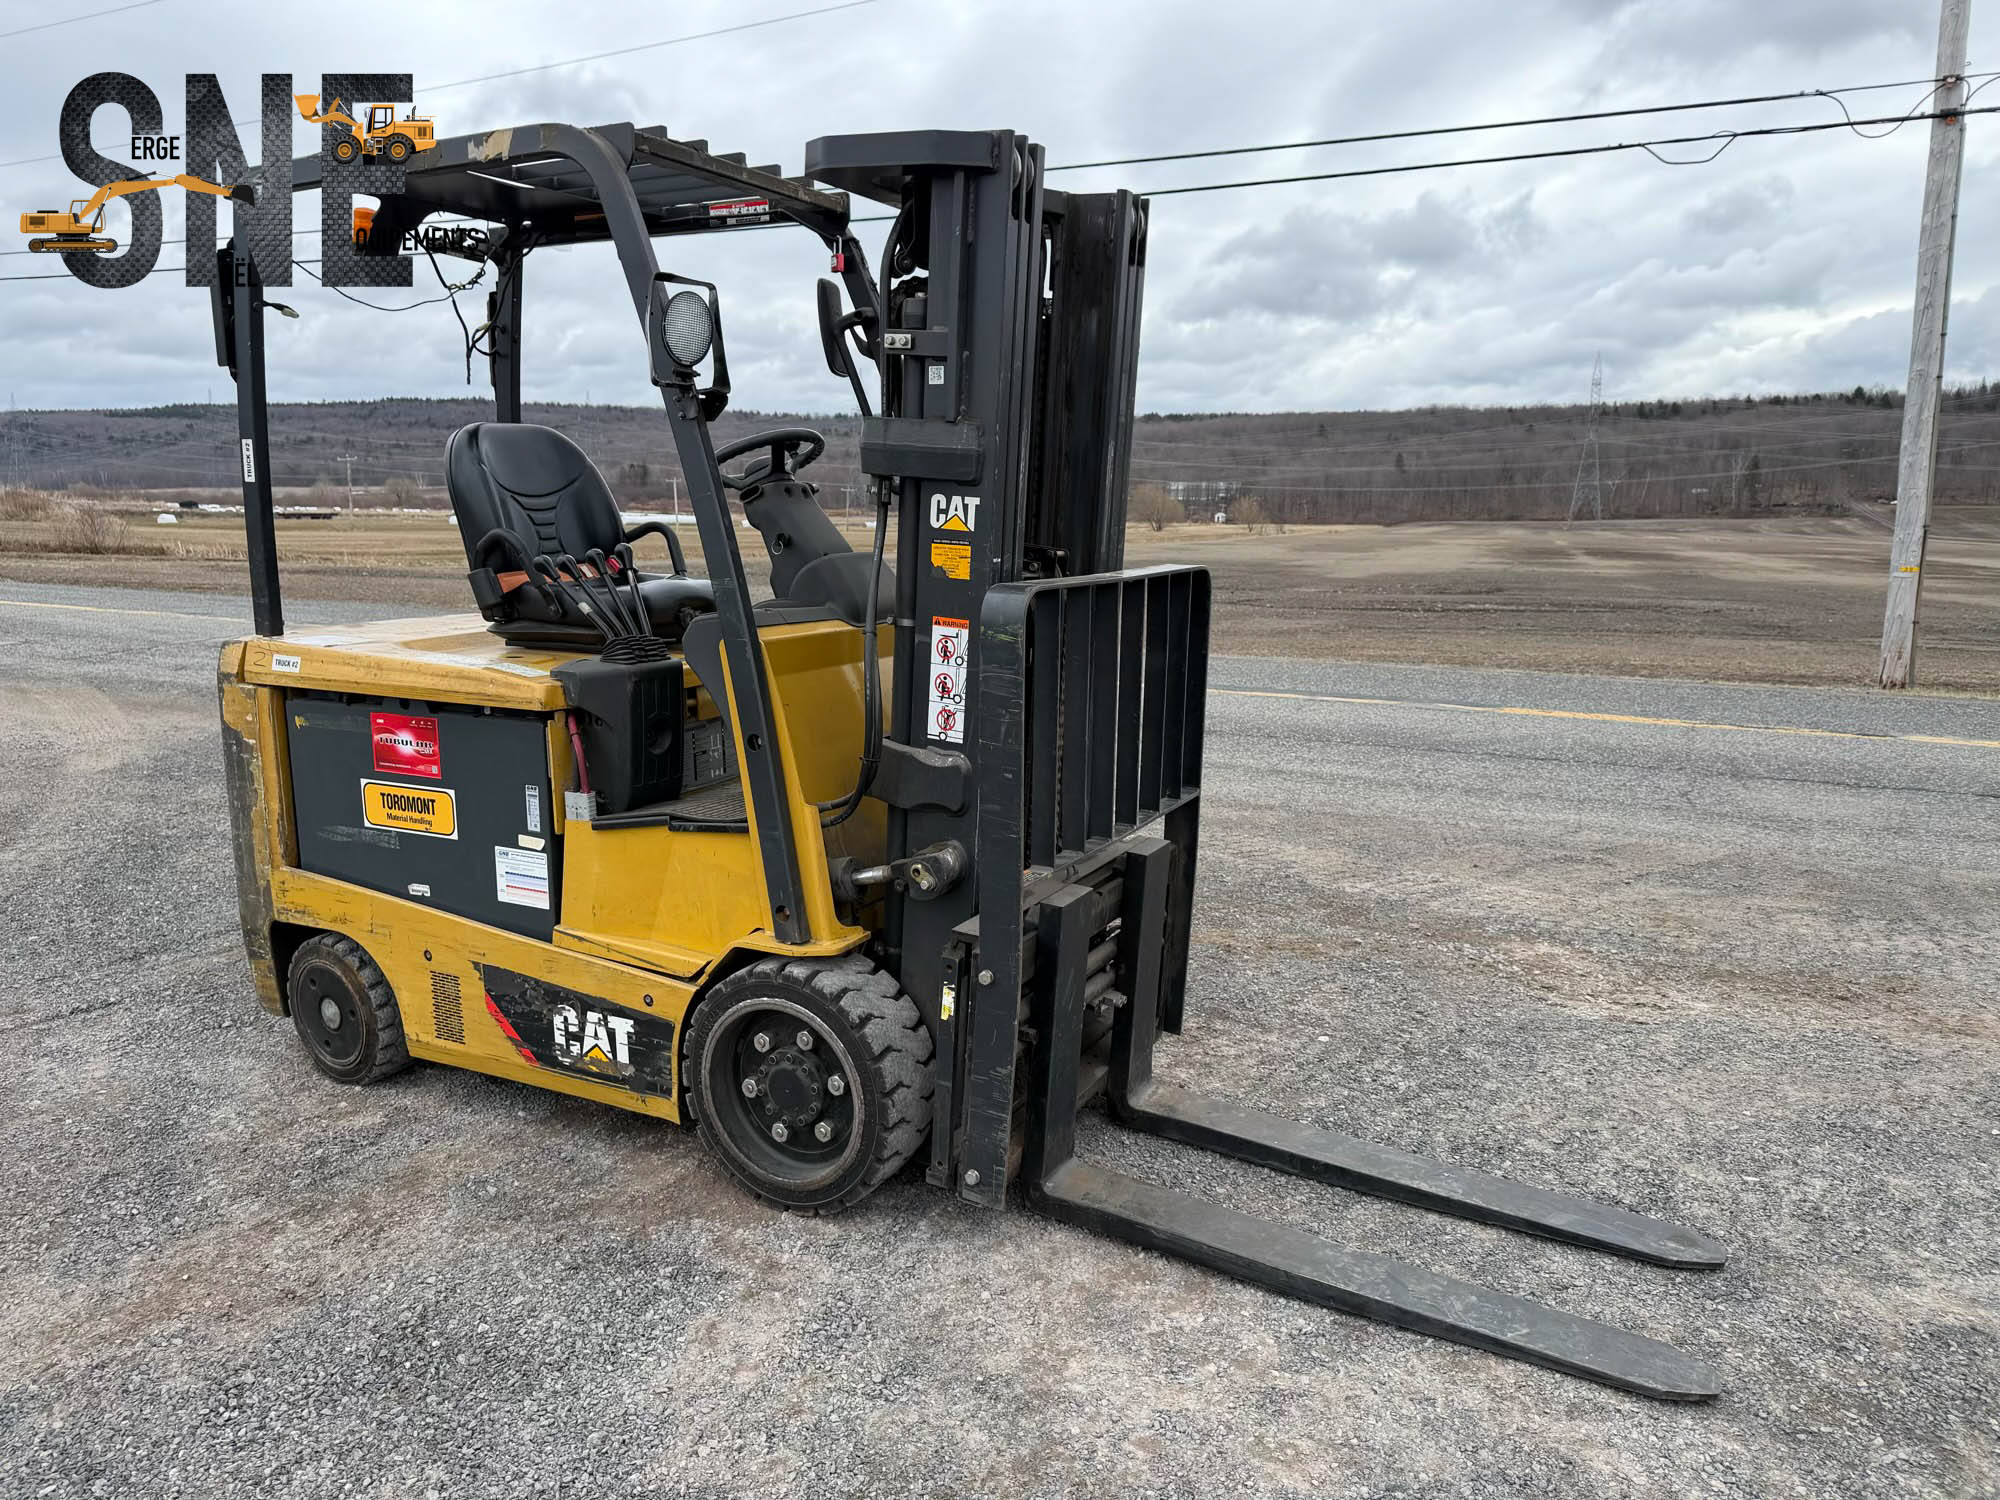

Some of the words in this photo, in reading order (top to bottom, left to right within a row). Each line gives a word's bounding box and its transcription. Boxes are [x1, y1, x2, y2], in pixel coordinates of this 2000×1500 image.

[930, 493, 981, 532] CAT
[942, 620, 968, 629] WARNING
[275, 658, 291, 667] TRUCK
[291, 660, 299, 669] #2
[380, 791, 436, 816] TOROMONT
[386, 812, 409, 823] Material
[409, 815, 433, 827] Handling
[553, 1004, 634, 1068] CAT
